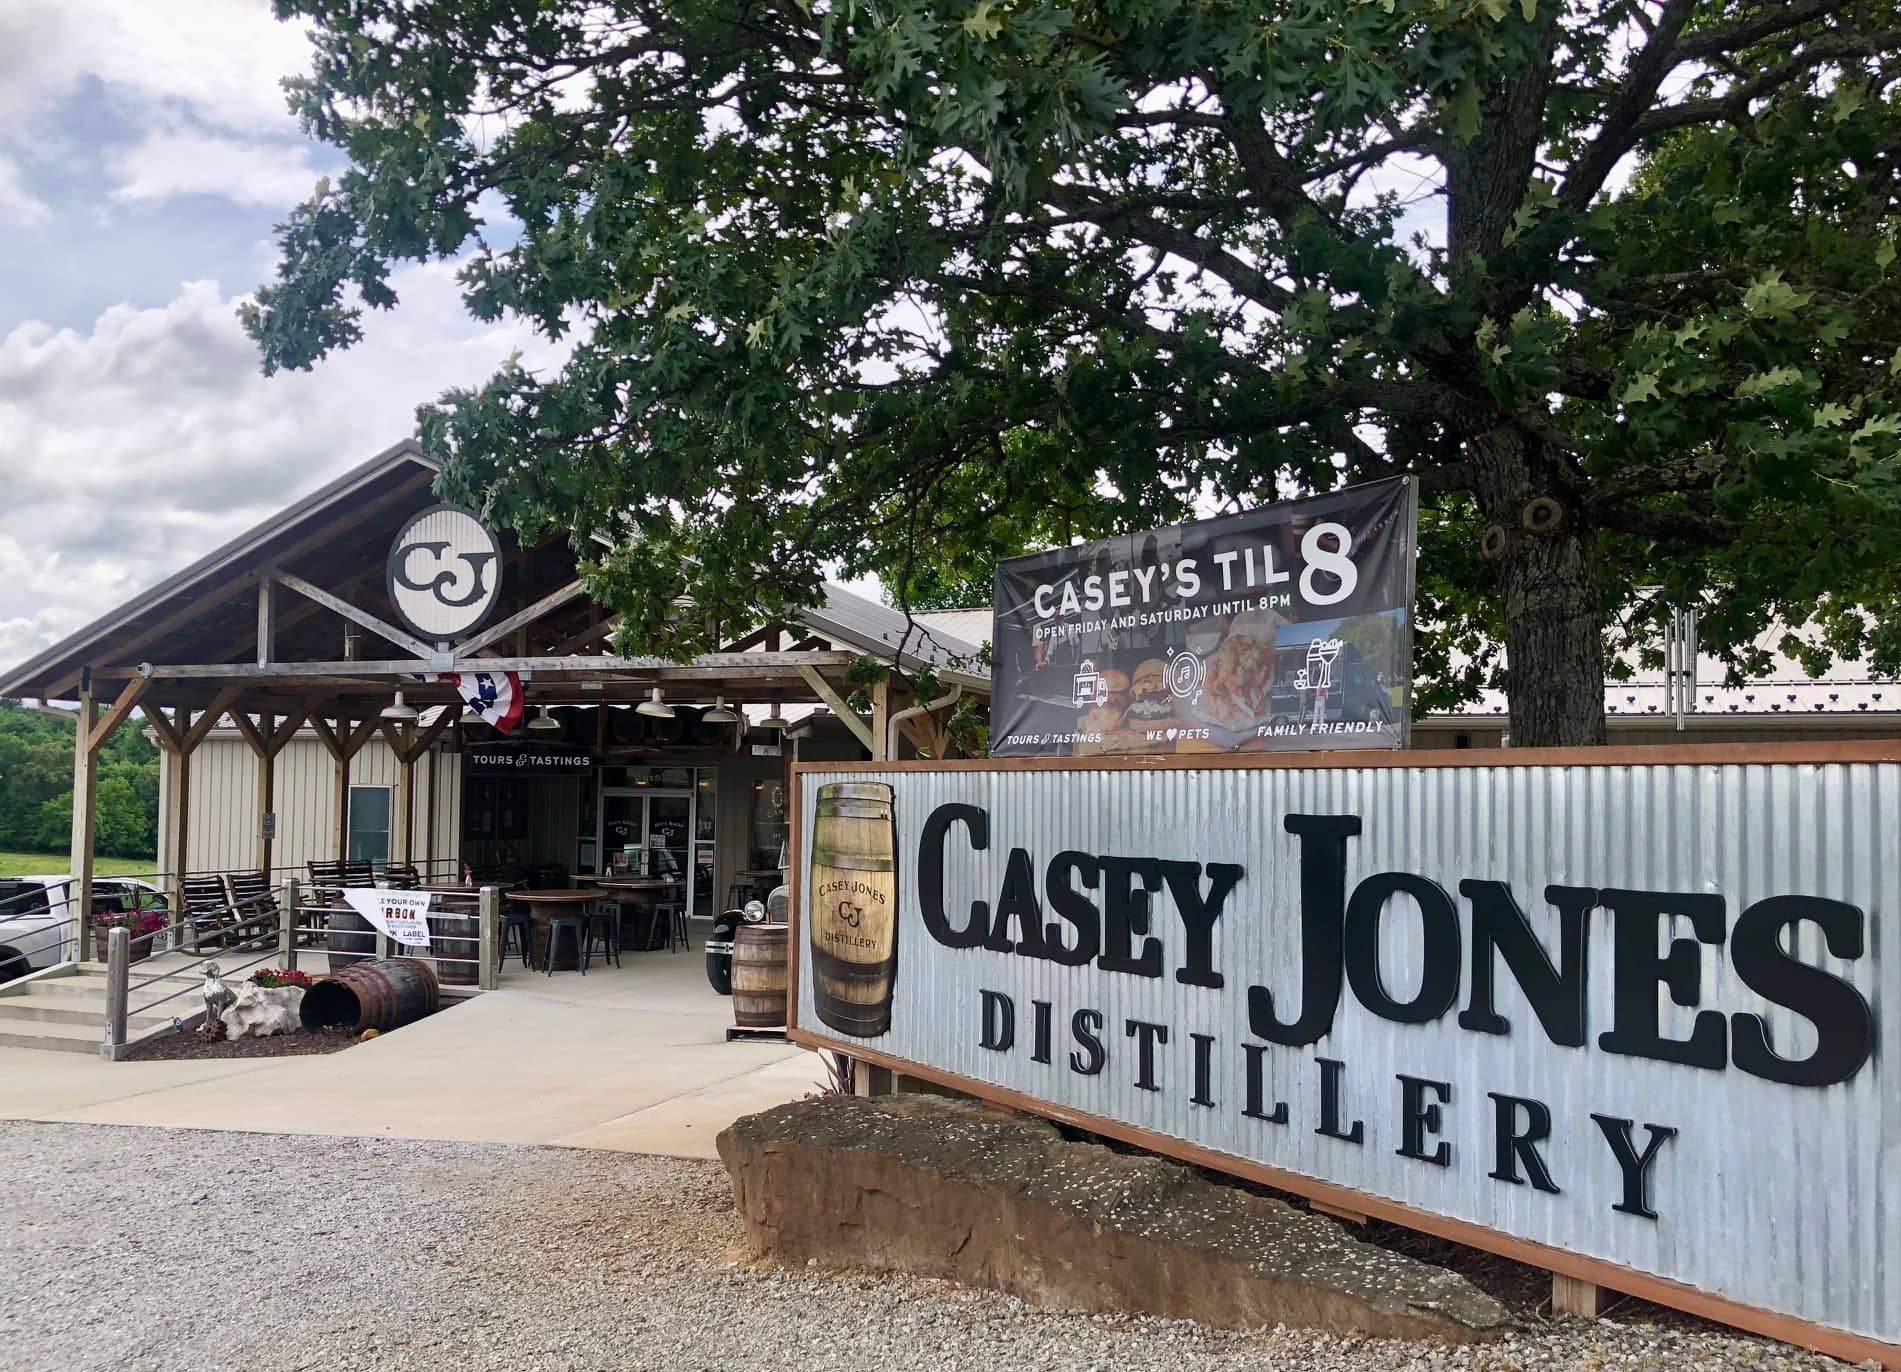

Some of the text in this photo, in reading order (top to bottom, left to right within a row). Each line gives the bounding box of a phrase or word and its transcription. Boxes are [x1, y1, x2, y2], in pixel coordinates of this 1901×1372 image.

[1034, 521, 1358, 619] CASEY'S TIL 8
[1035, 593, 1291, 639] OPEN FRIDAY AND SATURDAY UNTIL 8PM
[1145, 728, 1210, 741] WE PETS
[1257, 721, 1383, 737] FAMILY FRIENDLY
[1006, 734, 1039, 745] TOURS
[1052, 733, 1102, 744] TASTINGS
[473, 754, 590, 767] TOURS & TASTINGS
[819, 880, 886, 905] CASEY JONES
[409, 899, 426, 907] OWN
[385, 907, 416, 920] RBON
[838, 901, 863, 928] CJ
[403, 930, 426, 938] LABEL
[825, 931, 877, 950] DISTILLERY
[917, 802, 1872, 1086] CASEY JONES
[979, 988, 1679, 1221] DISTILLERY
